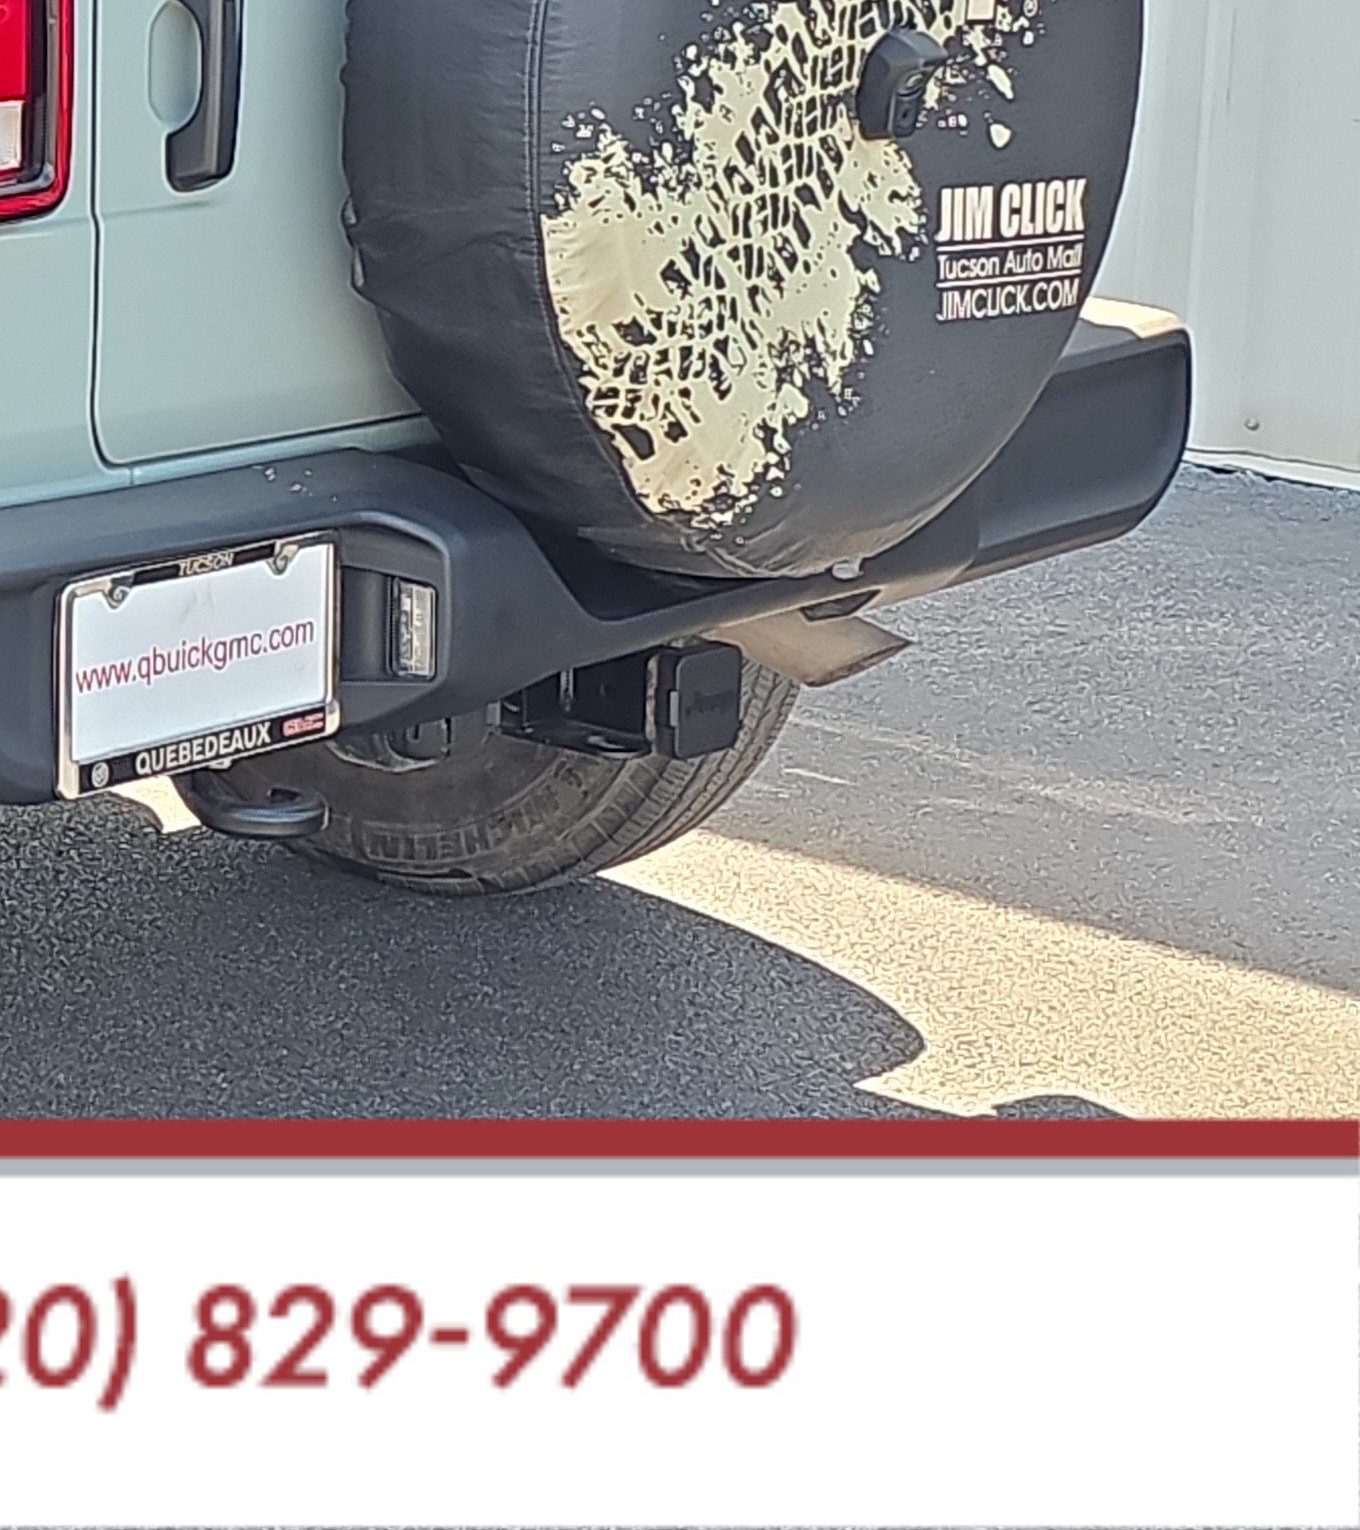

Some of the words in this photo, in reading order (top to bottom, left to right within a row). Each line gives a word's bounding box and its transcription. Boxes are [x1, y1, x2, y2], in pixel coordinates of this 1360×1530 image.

[934, 185, 994, 243] JIM
[999, 177, 1087, 239] CLICK
[936, 254, 1000, 280] Tucson
[1003, 248, 1045, 275] Auto
[1046, 243, 1084, 270] Mall
[178, 551, 234, 576] TUCSON
[75, 620, 314, 694] www.qbuickgmc.com
[134, 721, 273, 776] QUEBEDEAUX
